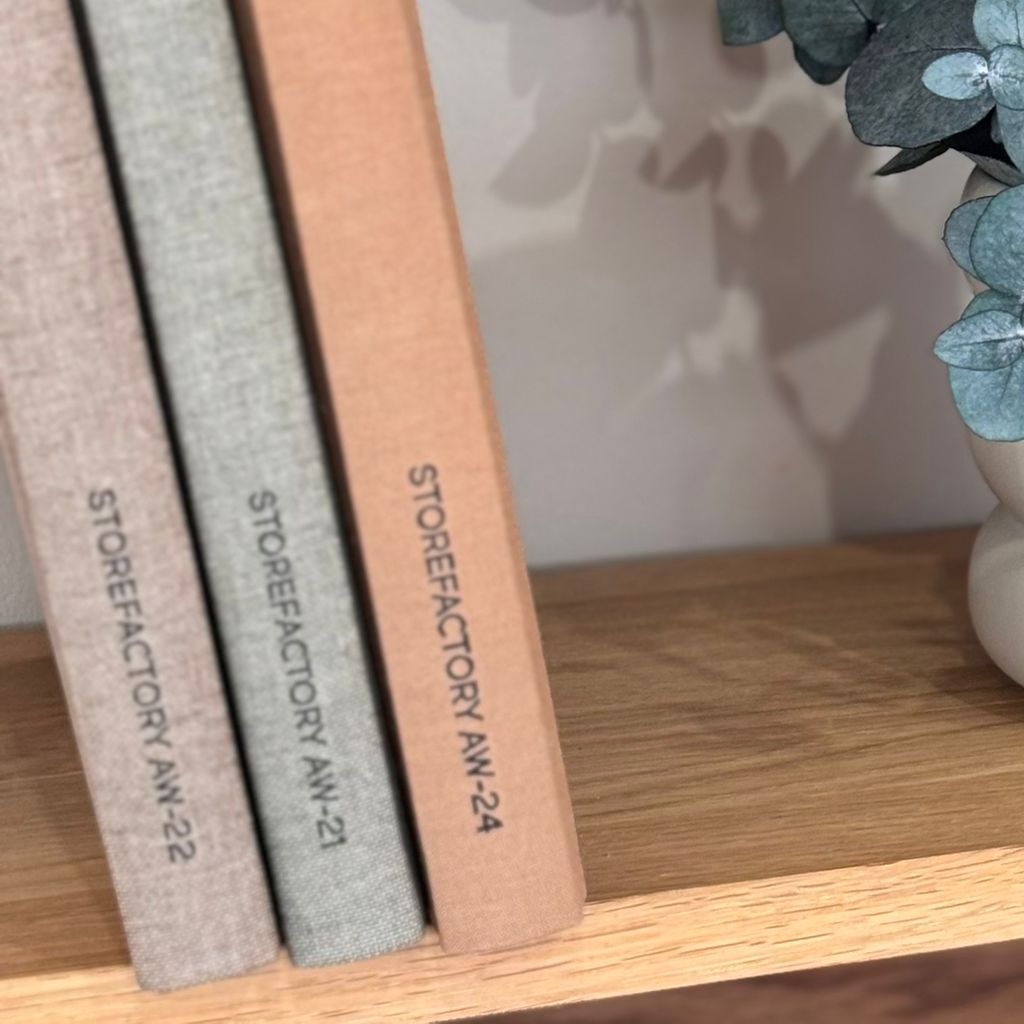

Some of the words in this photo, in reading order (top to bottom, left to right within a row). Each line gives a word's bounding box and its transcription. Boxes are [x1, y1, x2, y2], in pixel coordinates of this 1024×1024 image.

[88, 488, 171, 750] STOREFACTORY
[147, 755, 196, 864] AW-22
[249, 489, 327, 748] STOREFACTORY
[302, 755, 348, 850] AW-21
[408, 463, 485, 722] STOREFACTORY
[457, 728, 503, 835] AW-24
